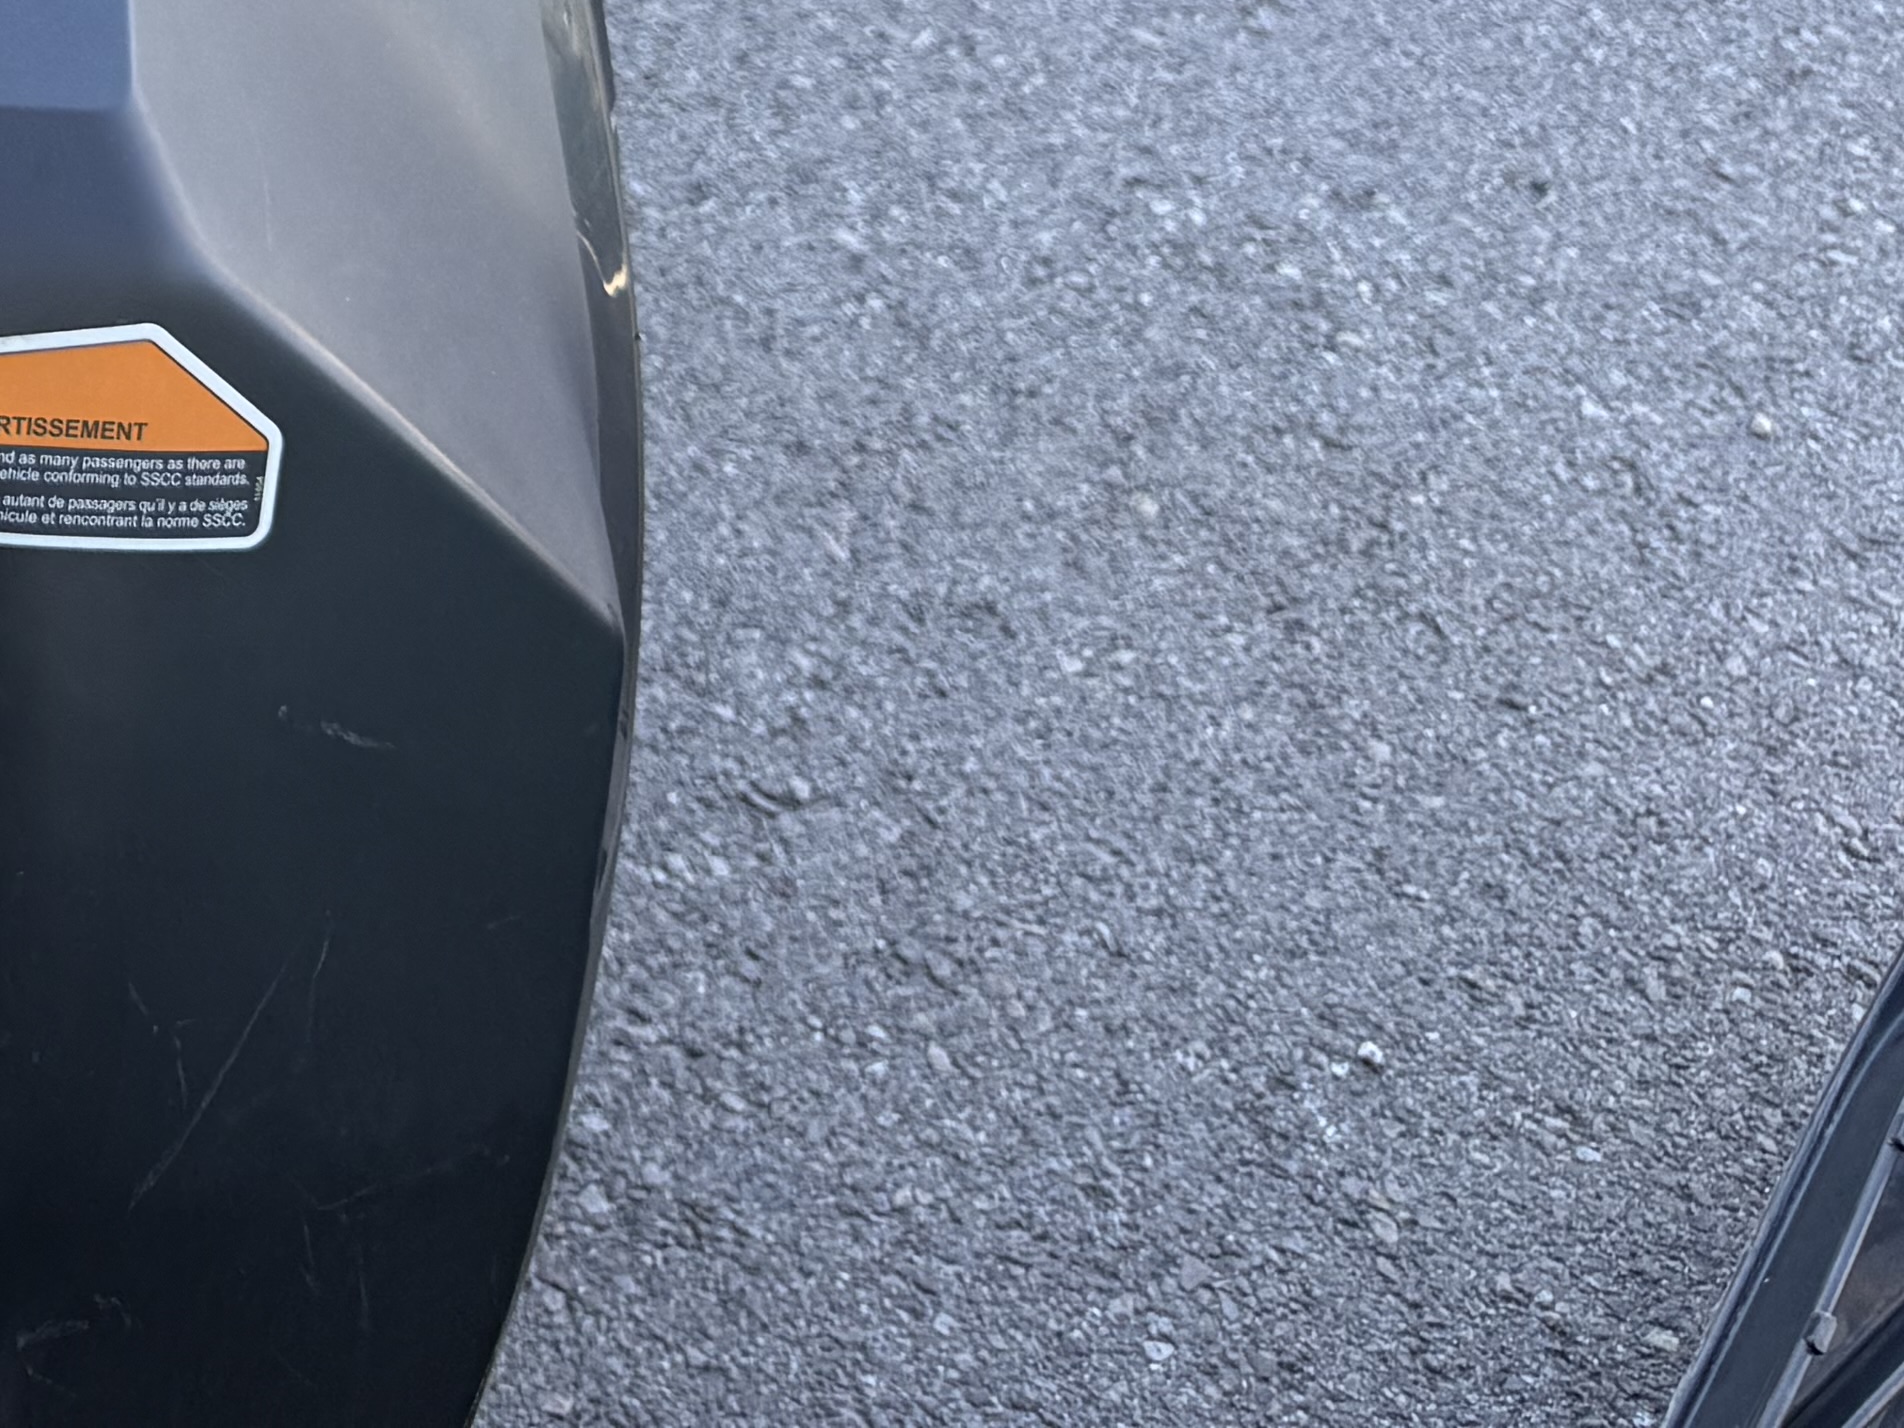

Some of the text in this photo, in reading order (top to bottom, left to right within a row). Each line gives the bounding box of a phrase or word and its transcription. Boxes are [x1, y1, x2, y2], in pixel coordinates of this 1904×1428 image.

[18, 453, 36, 464] as
[39, 453, 78, 470] many
[81, 454, 164, 474] passengers
[167, 458, 184, 469] as
[186, 456, 221, 470] there
[224, 458, 245, 469] are
[43, 469, 120, 488] conforming
[122, 472, 137, 485] to
[140, 470, 182, 487] SSCC
[184, 470, 250, 488] standards.
[2, 492, 45, 507] autant
[47, 494, 65, 508] de
[67, 496, 136, 514] passagers
[166, 501, 176, 514] y
[178, 501, 187, 511] a
[189, 498, 206, 510] de
[207, 497, 249, 516] sièges
[40, 511, 56, 523] et
[58, 512, 138, 527] rencontrant
[140, 515, 154, 528] la
[156, 516, 199, 529] norme
[202, 511, 246, 528] SSCC.
